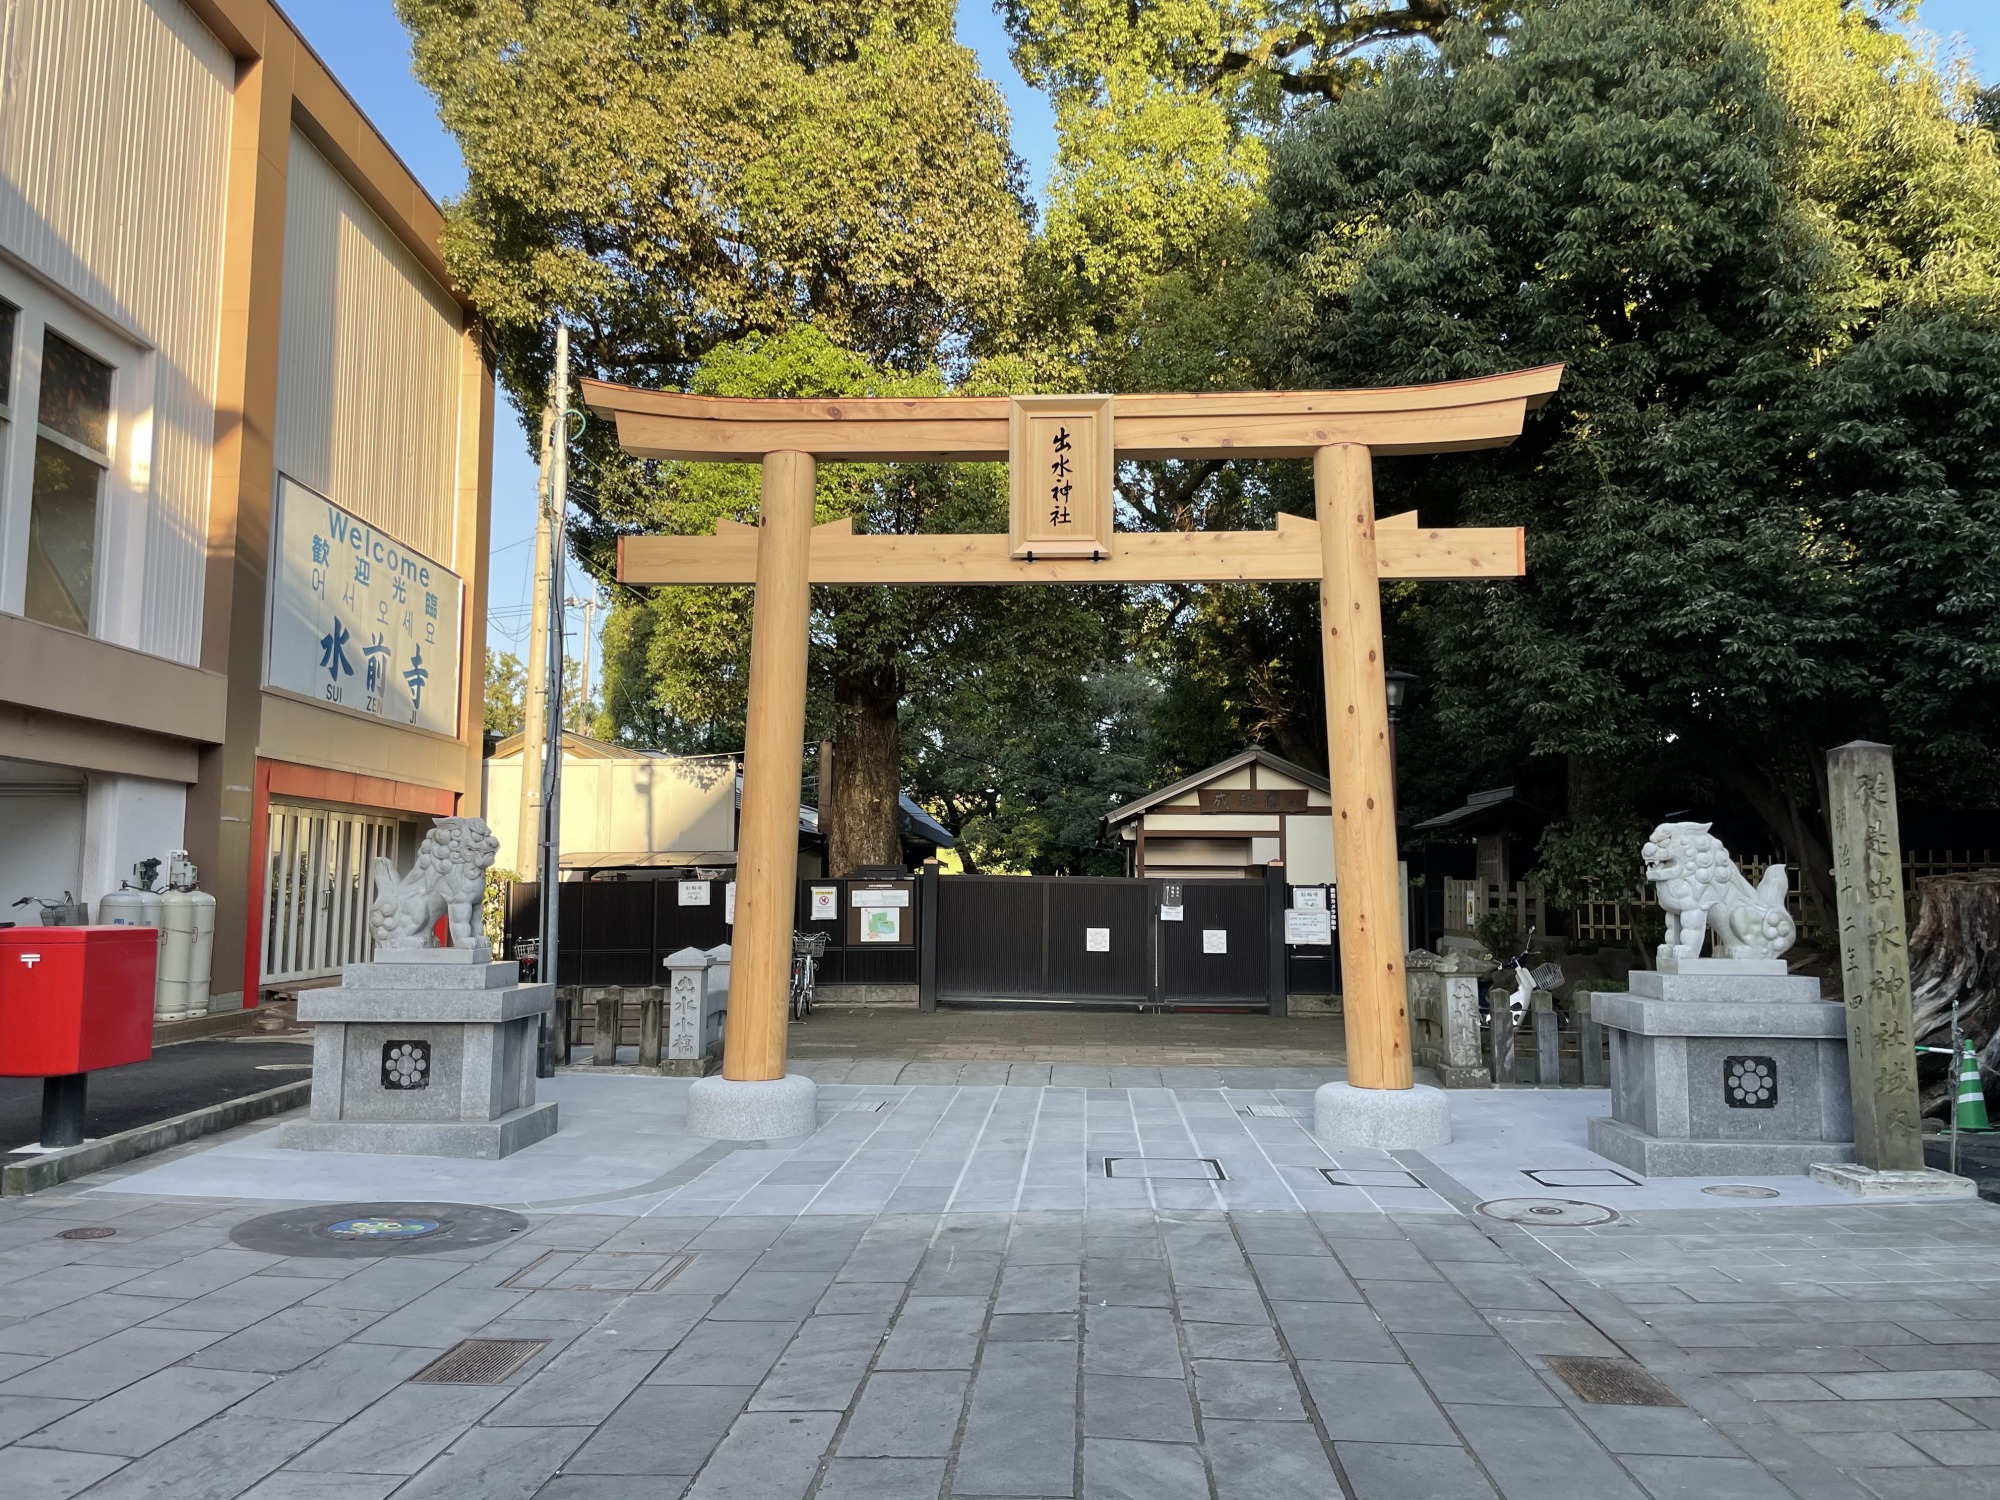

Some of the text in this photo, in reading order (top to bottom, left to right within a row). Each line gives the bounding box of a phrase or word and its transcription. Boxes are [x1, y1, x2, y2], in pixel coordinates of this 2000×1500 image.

[1049, 426, 1074, 527] 出水神社
[311, 533, 439, 620] 歓迎光臨
[328, 506, 430, 588] Welcome
[311, 568, 436, 646] 어서오세요
[319, 615, 430, 710] 水前寺
[326, 683, 417, 724] SUI ZEN JI
